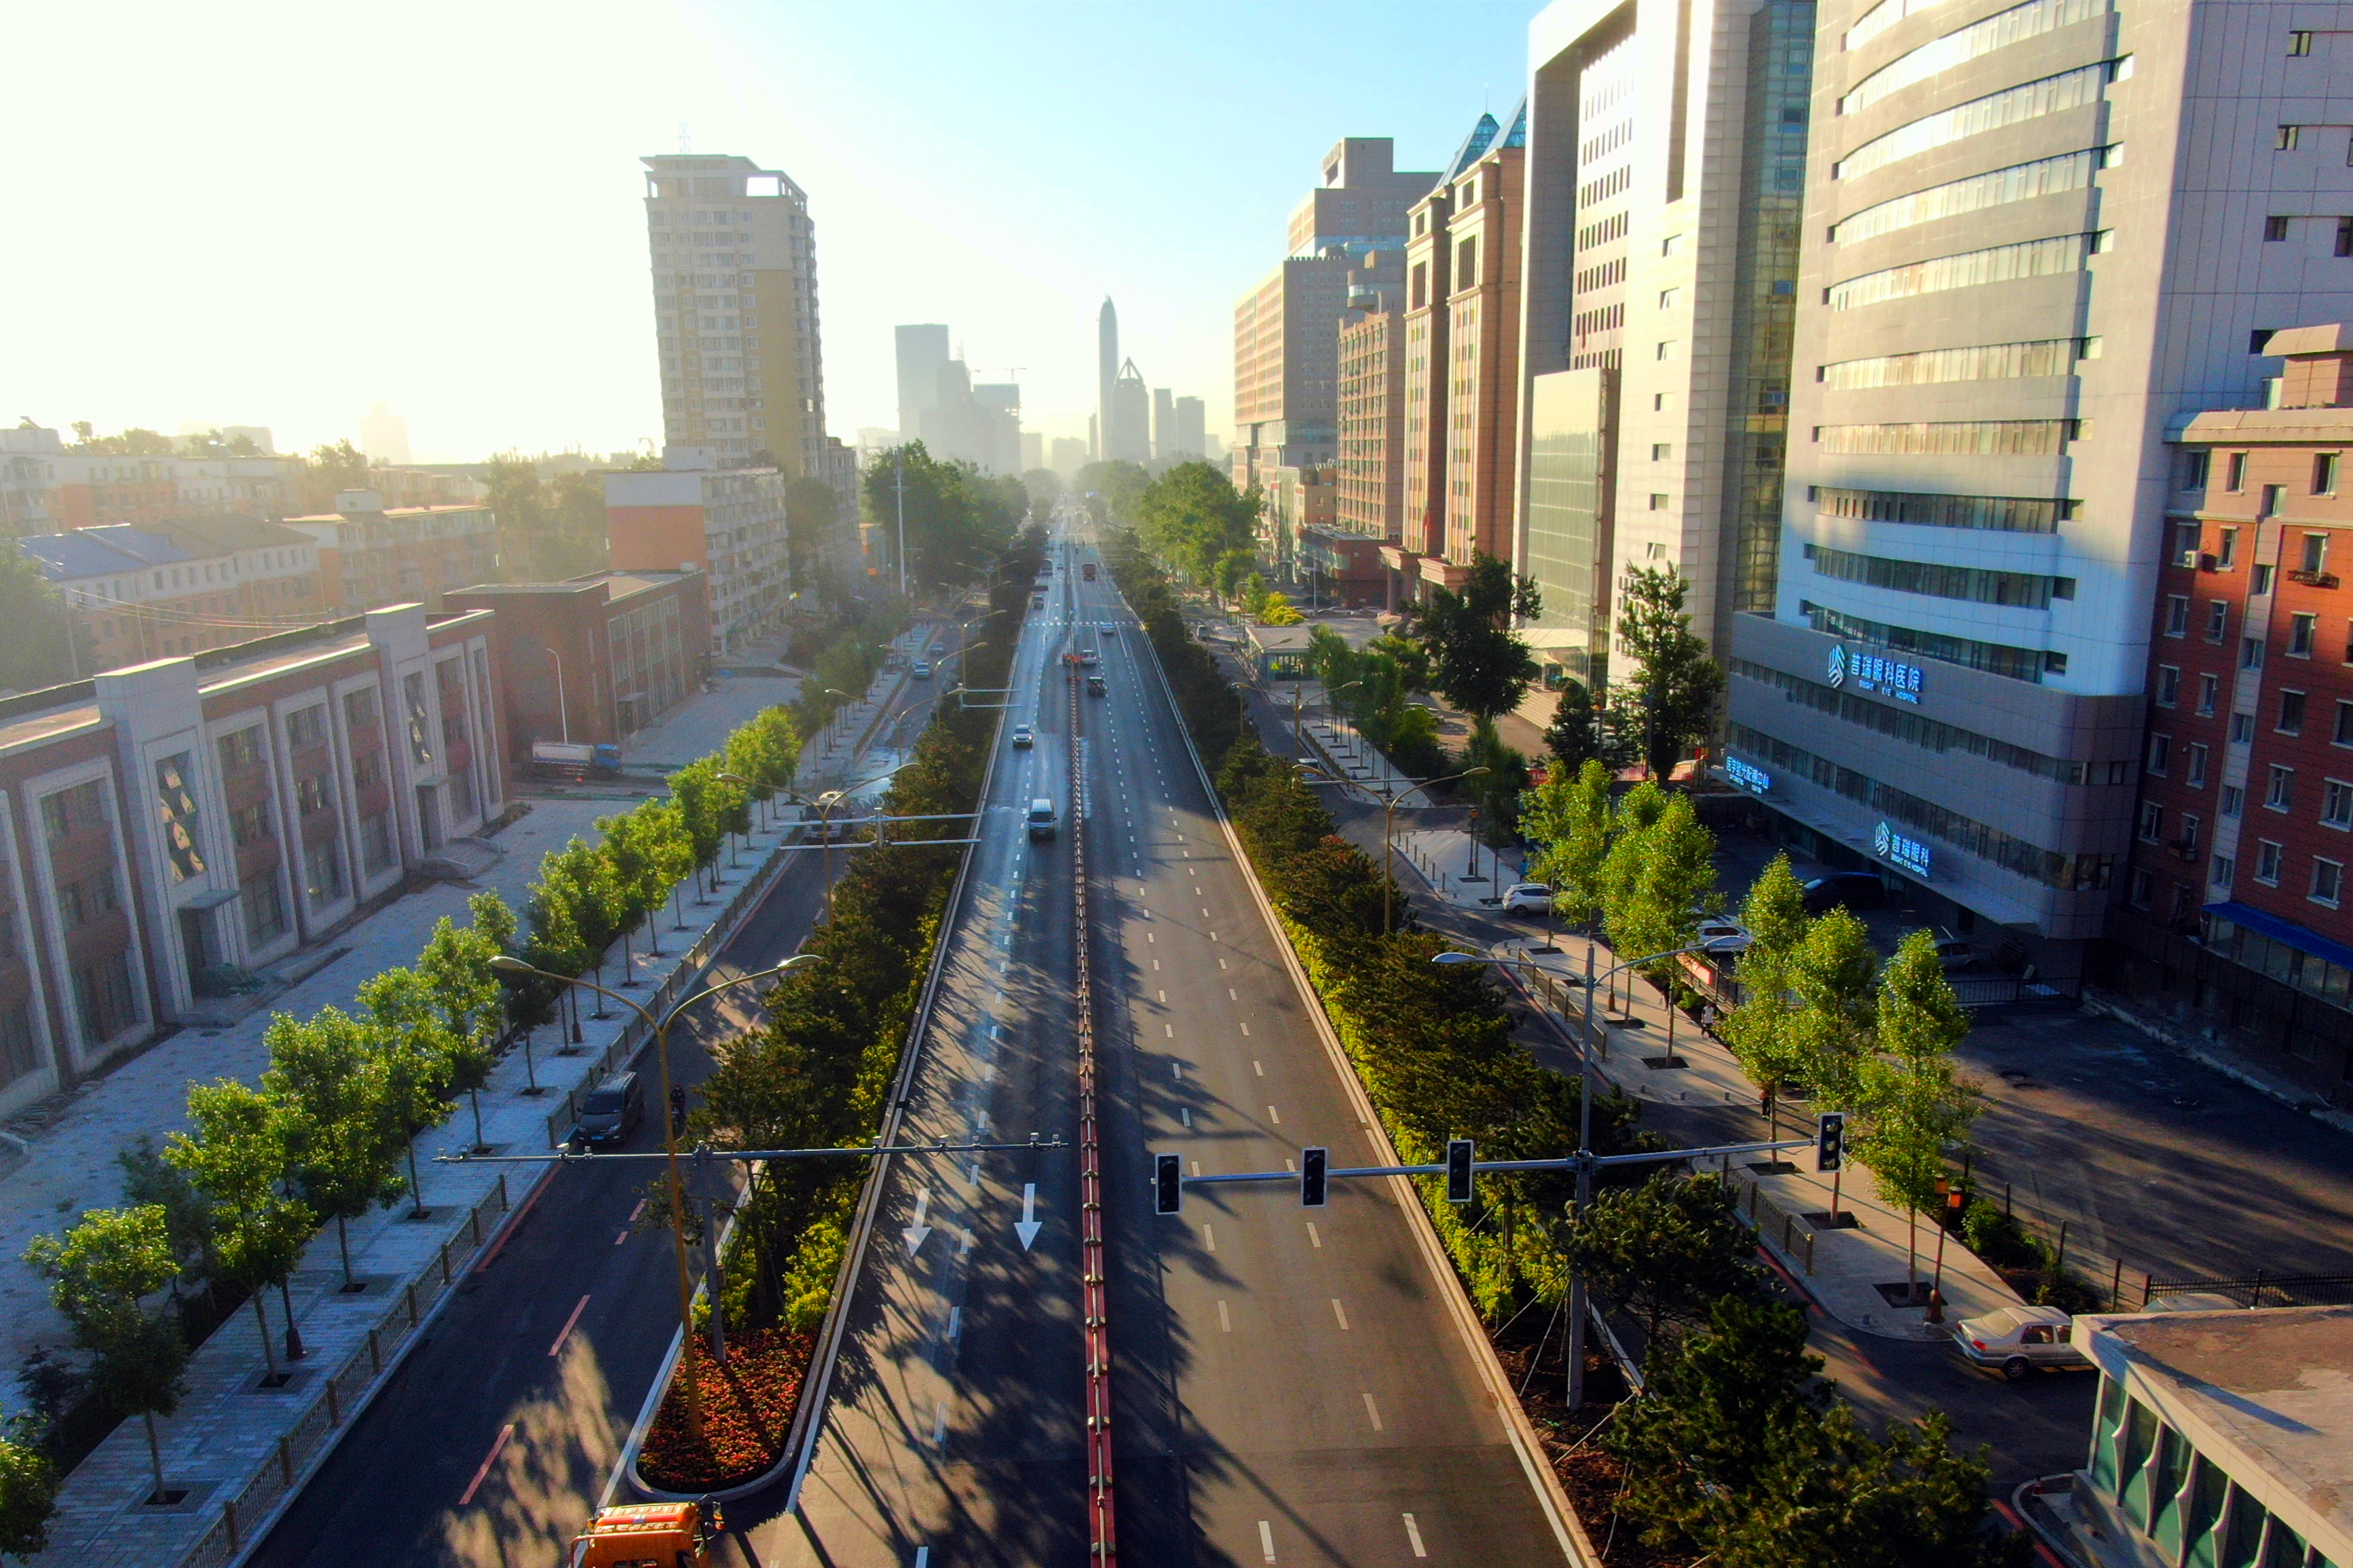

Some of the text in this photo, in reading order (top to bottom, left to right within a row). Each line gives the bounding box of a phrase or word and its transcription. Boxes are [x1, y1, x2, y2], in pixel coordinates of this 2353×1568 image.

[1851, 653, 1919, 692] 普瑞眼科医院
[1882, 687, 1891, 697] EYE
[1892, 834, 1929, 867] 普瑞眼科
